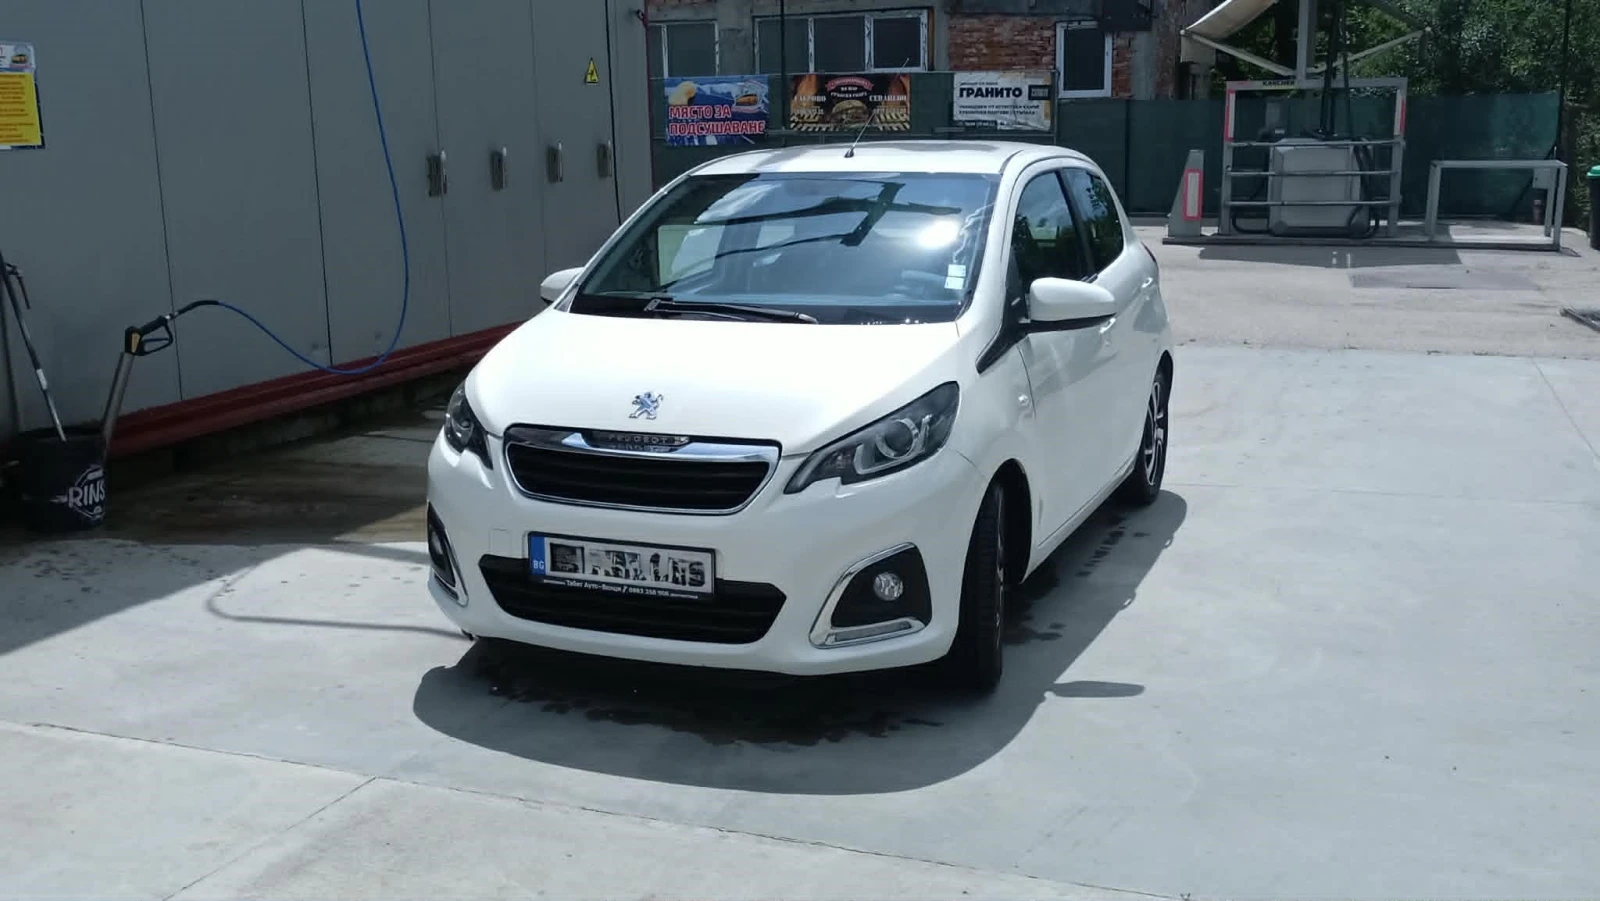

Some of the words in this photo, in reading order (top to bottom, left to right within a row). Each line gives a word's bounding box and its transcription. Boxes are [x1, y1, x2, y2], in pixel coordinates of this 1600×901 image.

[959, 87, 1023, 98] ГРАНИТО
[668, 105, 713, 119] МЯСТО
[714, 105, 732, 118] ЗА
[669, 120, 766, 136] ПОДСУШАВАНЕ
[532, 559, 545, 569] BG
